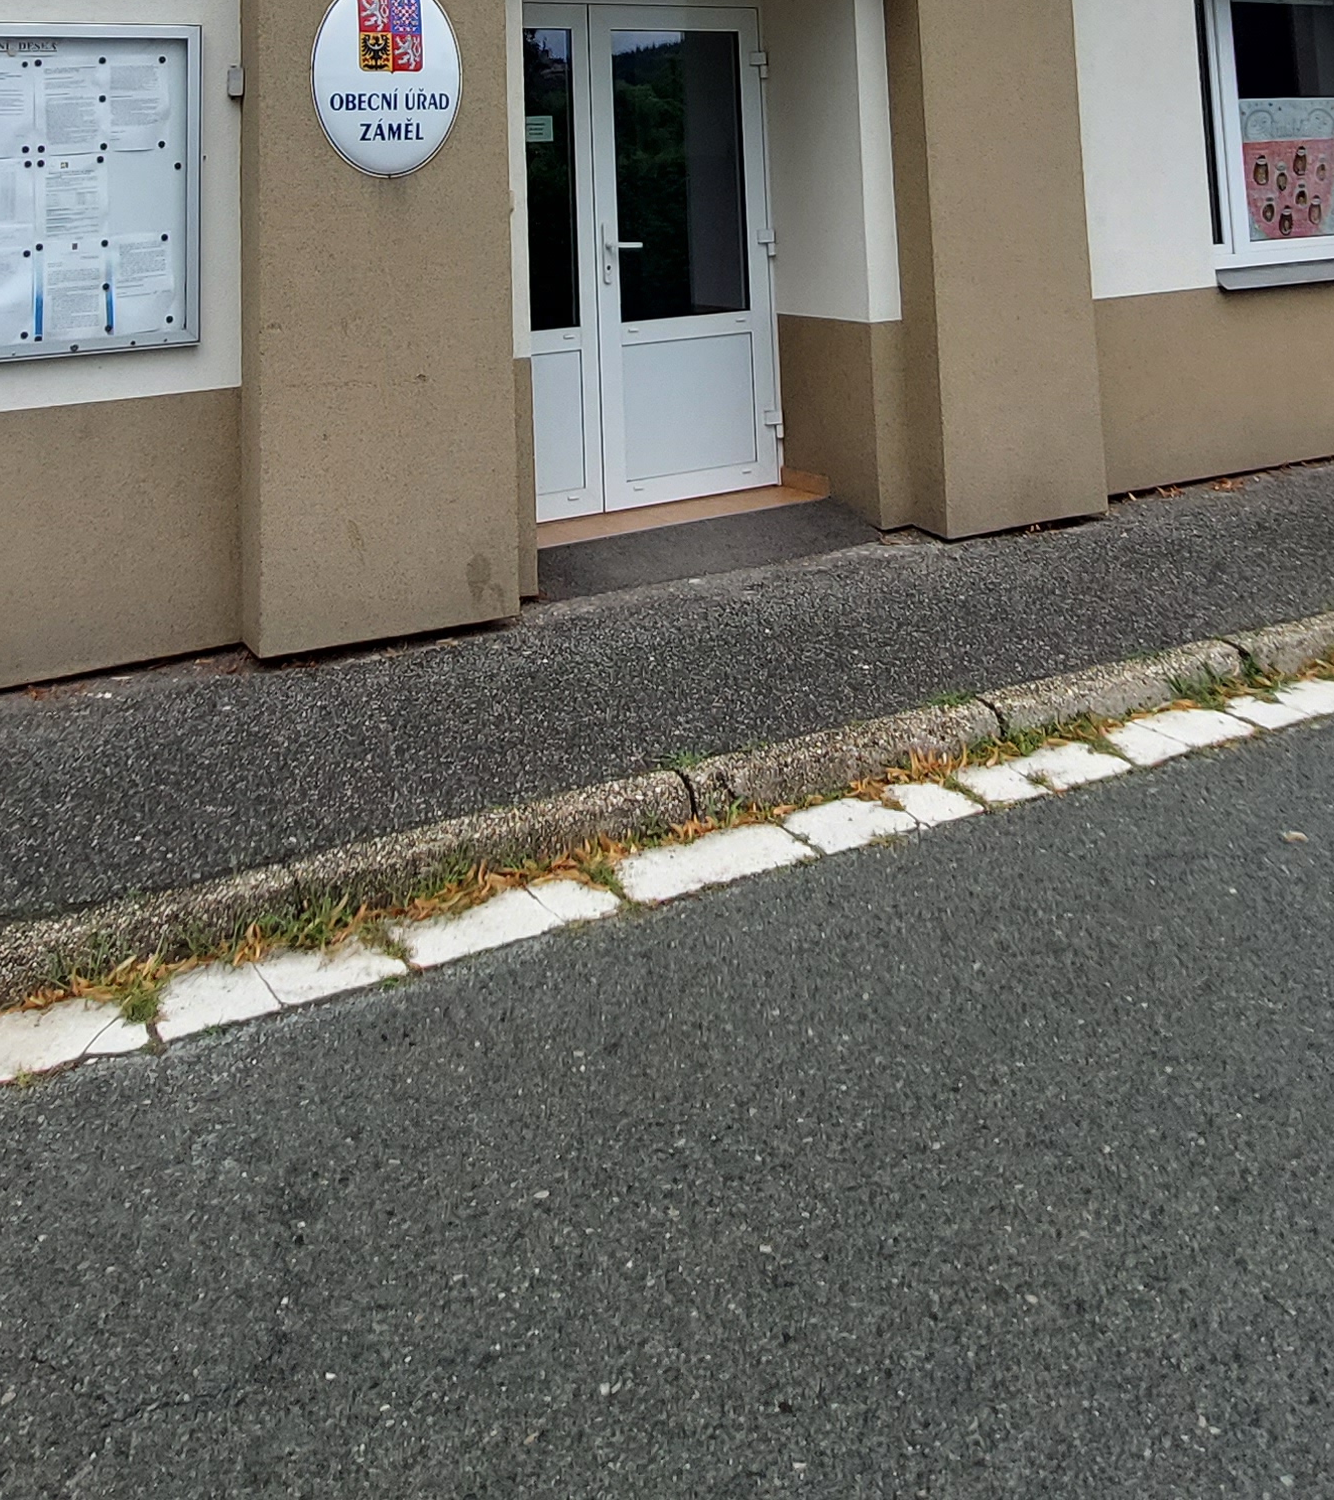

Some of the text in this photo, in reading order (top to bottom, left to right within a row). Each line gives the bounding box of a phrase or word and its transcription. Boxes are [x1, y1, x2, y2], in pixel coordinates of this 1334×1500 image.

[329, 87, 450, 111] OBECNÍ ÚŘAD
[359, 117, 424, 142] ZÁMĚL
